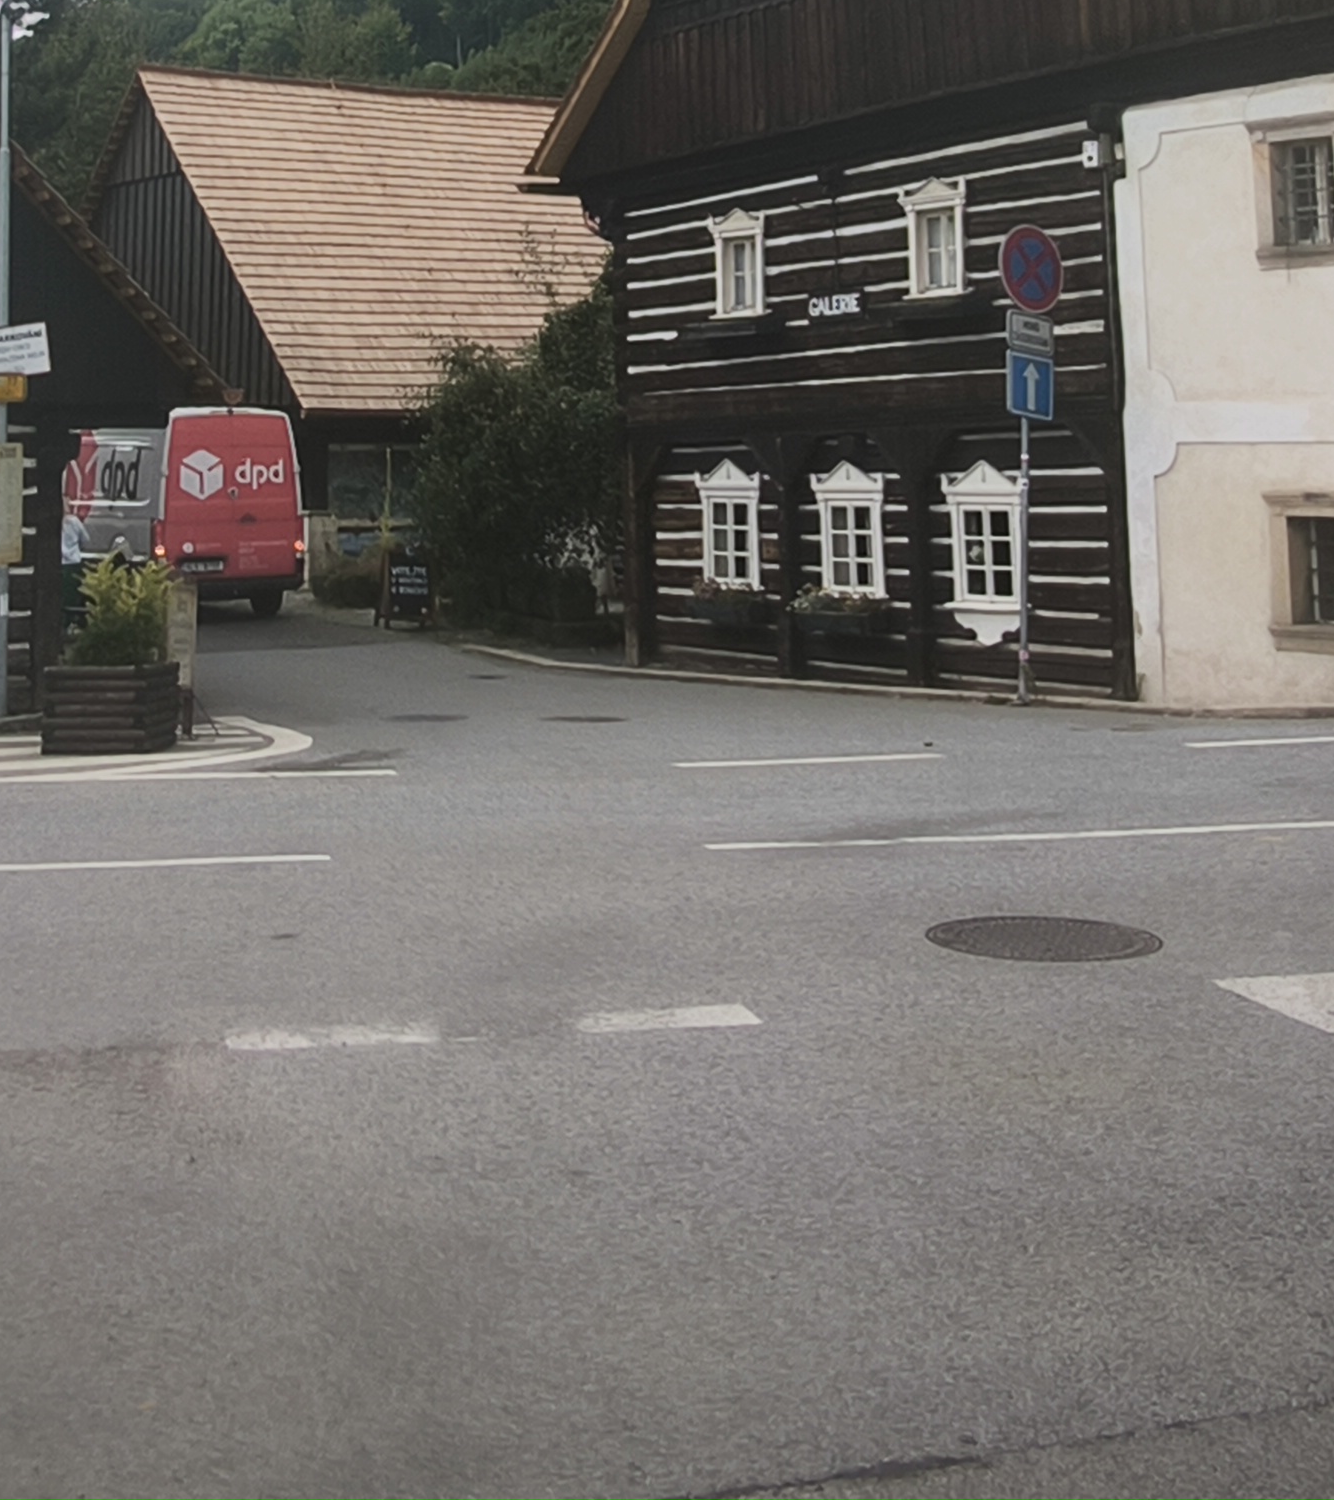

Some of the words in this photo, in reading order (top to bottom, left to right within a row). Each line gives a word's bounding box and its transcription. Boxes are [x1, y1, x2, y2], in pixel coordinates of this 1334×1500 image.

[808, 293, 861, 317] GALERIE
[101, 447, 142, 500] dpd
[234, 457, 284, 490] dpd
